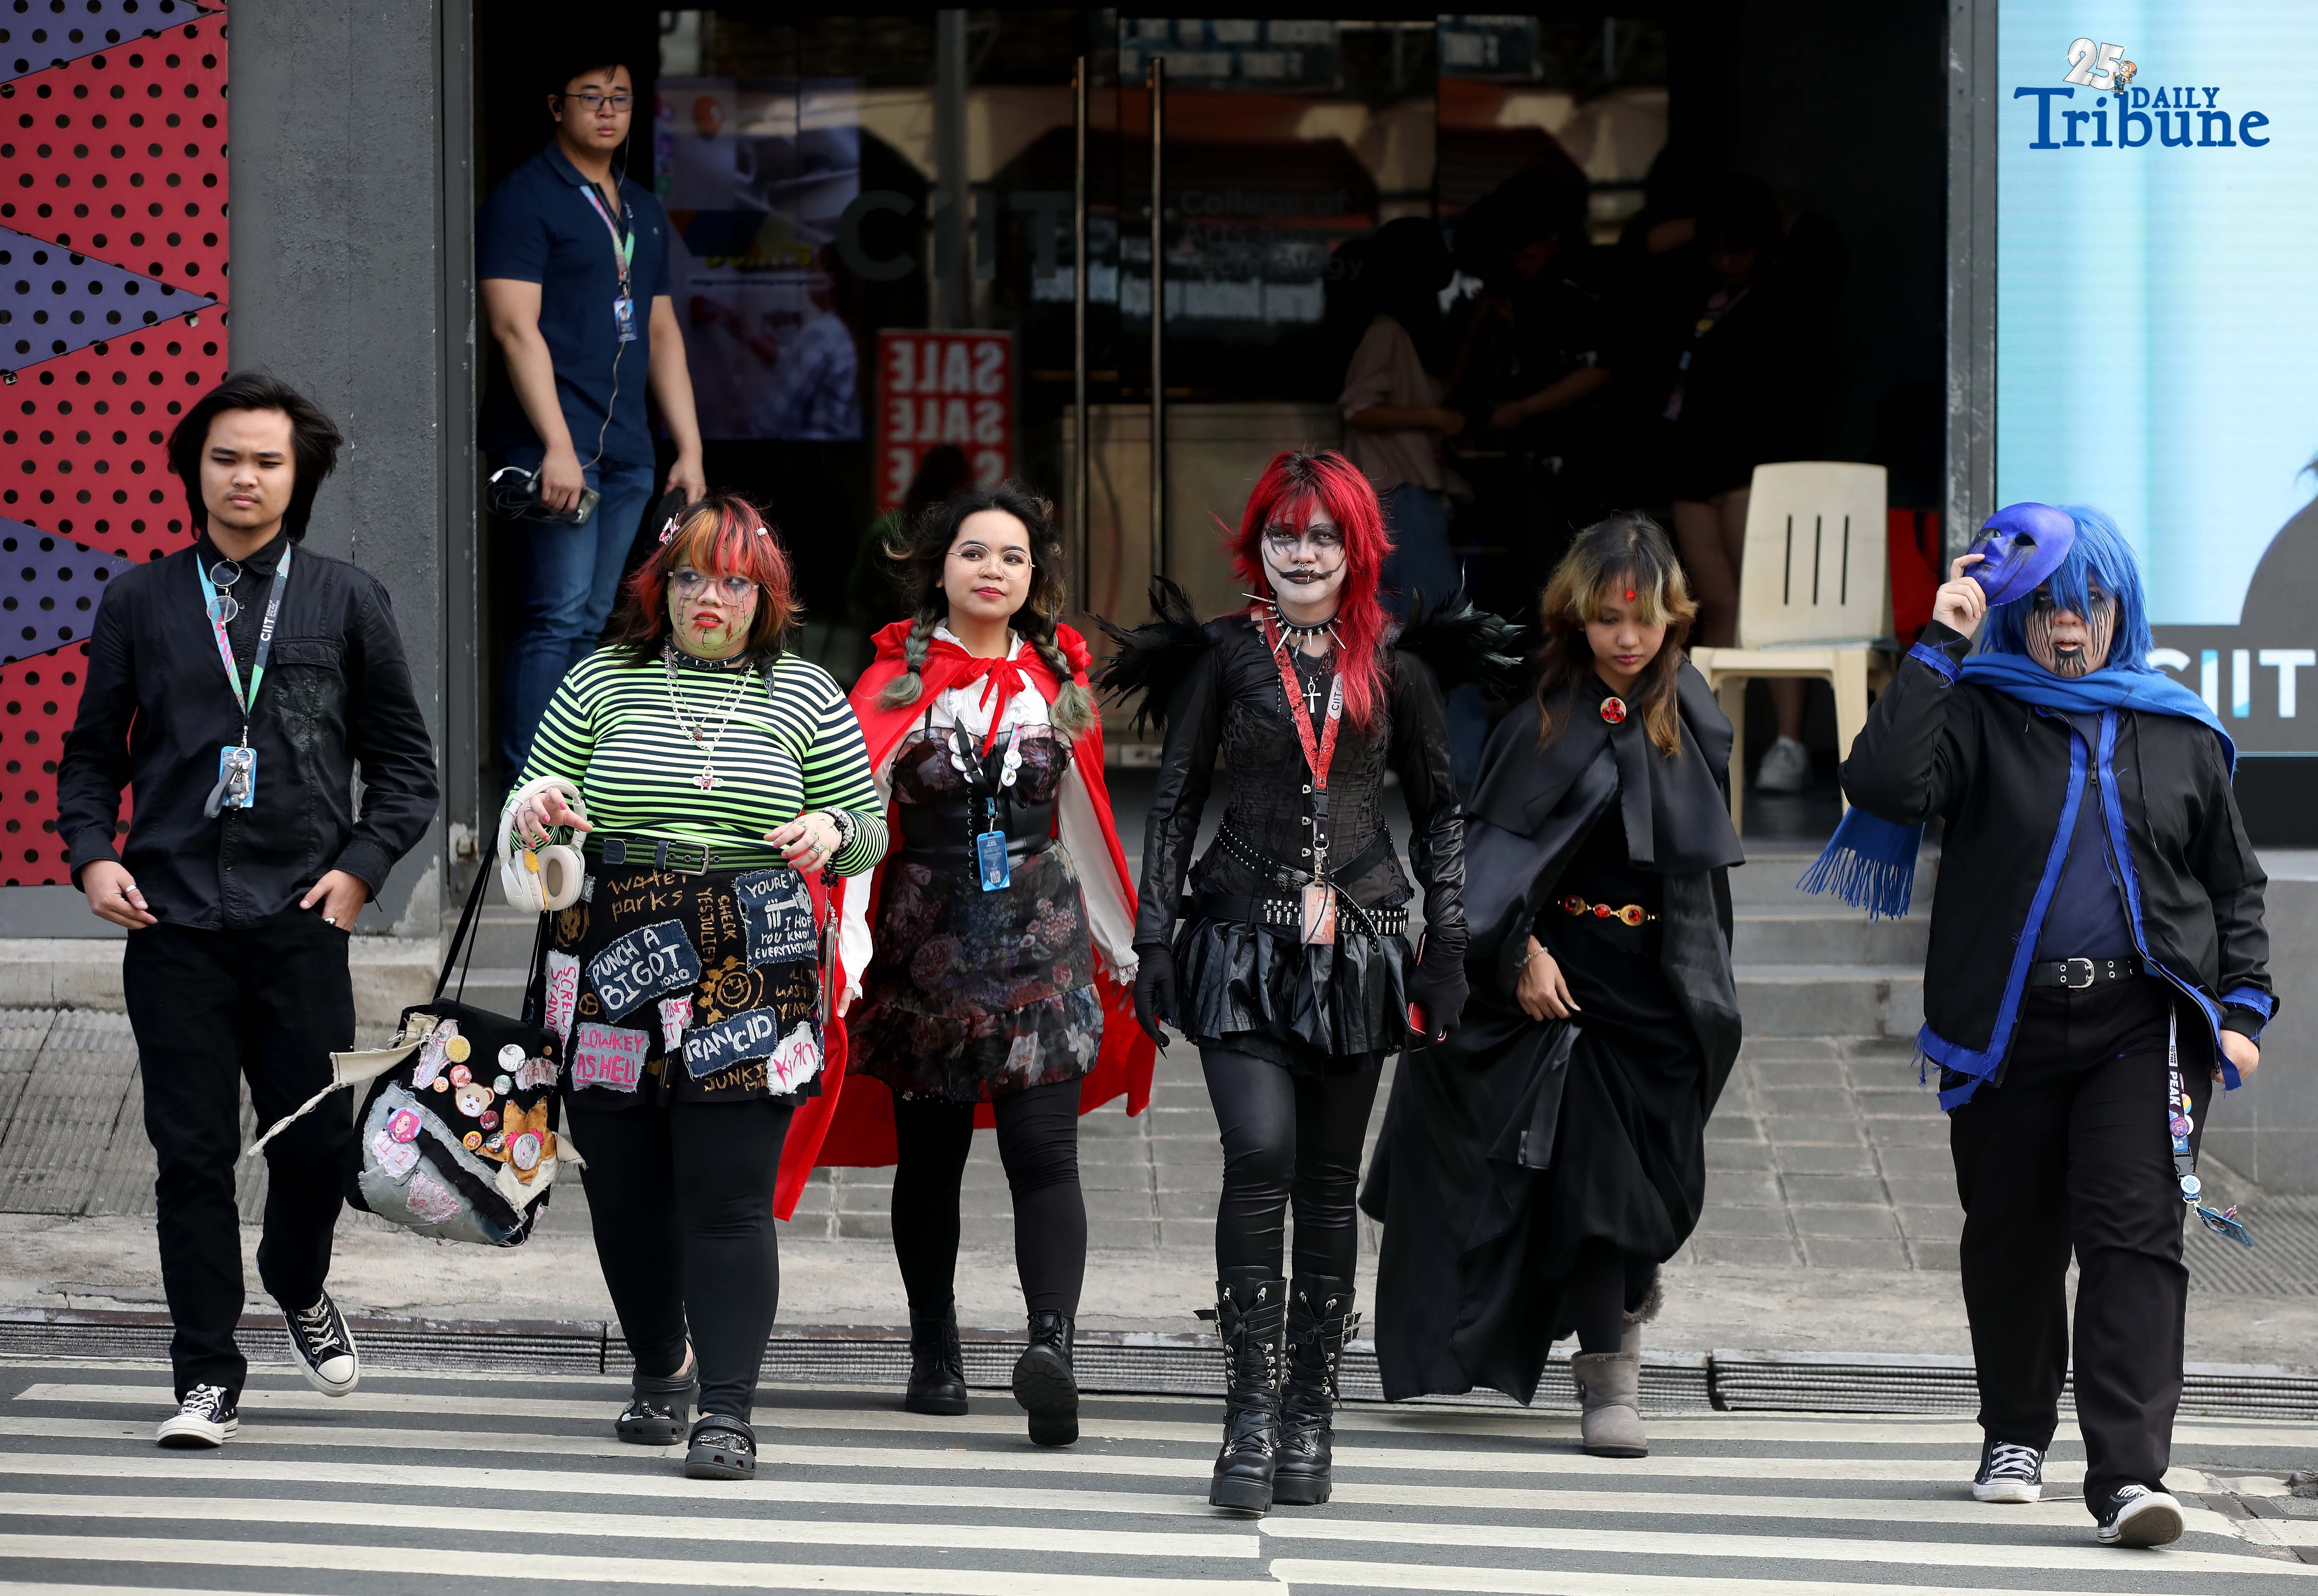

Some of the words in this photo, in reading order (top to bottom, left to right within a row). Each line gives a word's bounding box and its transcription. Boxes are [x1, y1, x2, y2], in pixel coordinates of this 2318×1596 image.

[260, 616, 275, 641] CIIT
[1331, 692, 1342, 711] CIIT
[745, 873, 789, 898] YOURE
[612, 890, 683, 923] parks
[718, 895, 737, 942] CHECK
[784, 916, 791, 931] I
[795, 914, 812, 929] HOP
[761, 932, 782, 945] YOU
[592, 938, 641, 986] PUNCH
[643, 929, 661, 950] A
[599, 943, 680, 1010] BIGOT
[545, 965, 563, 1034] STANDA
[560, 964, 576, 1029] SCREW
[581, 1029, 645, 1054] LOWKEY
[685, 1015, 773, 1062] RANCID
[575, 1053, 596, 1078] AS
[599, 1054, 637, 1083] HELL
[2170, 1071, 2181, 1107] PEAK
